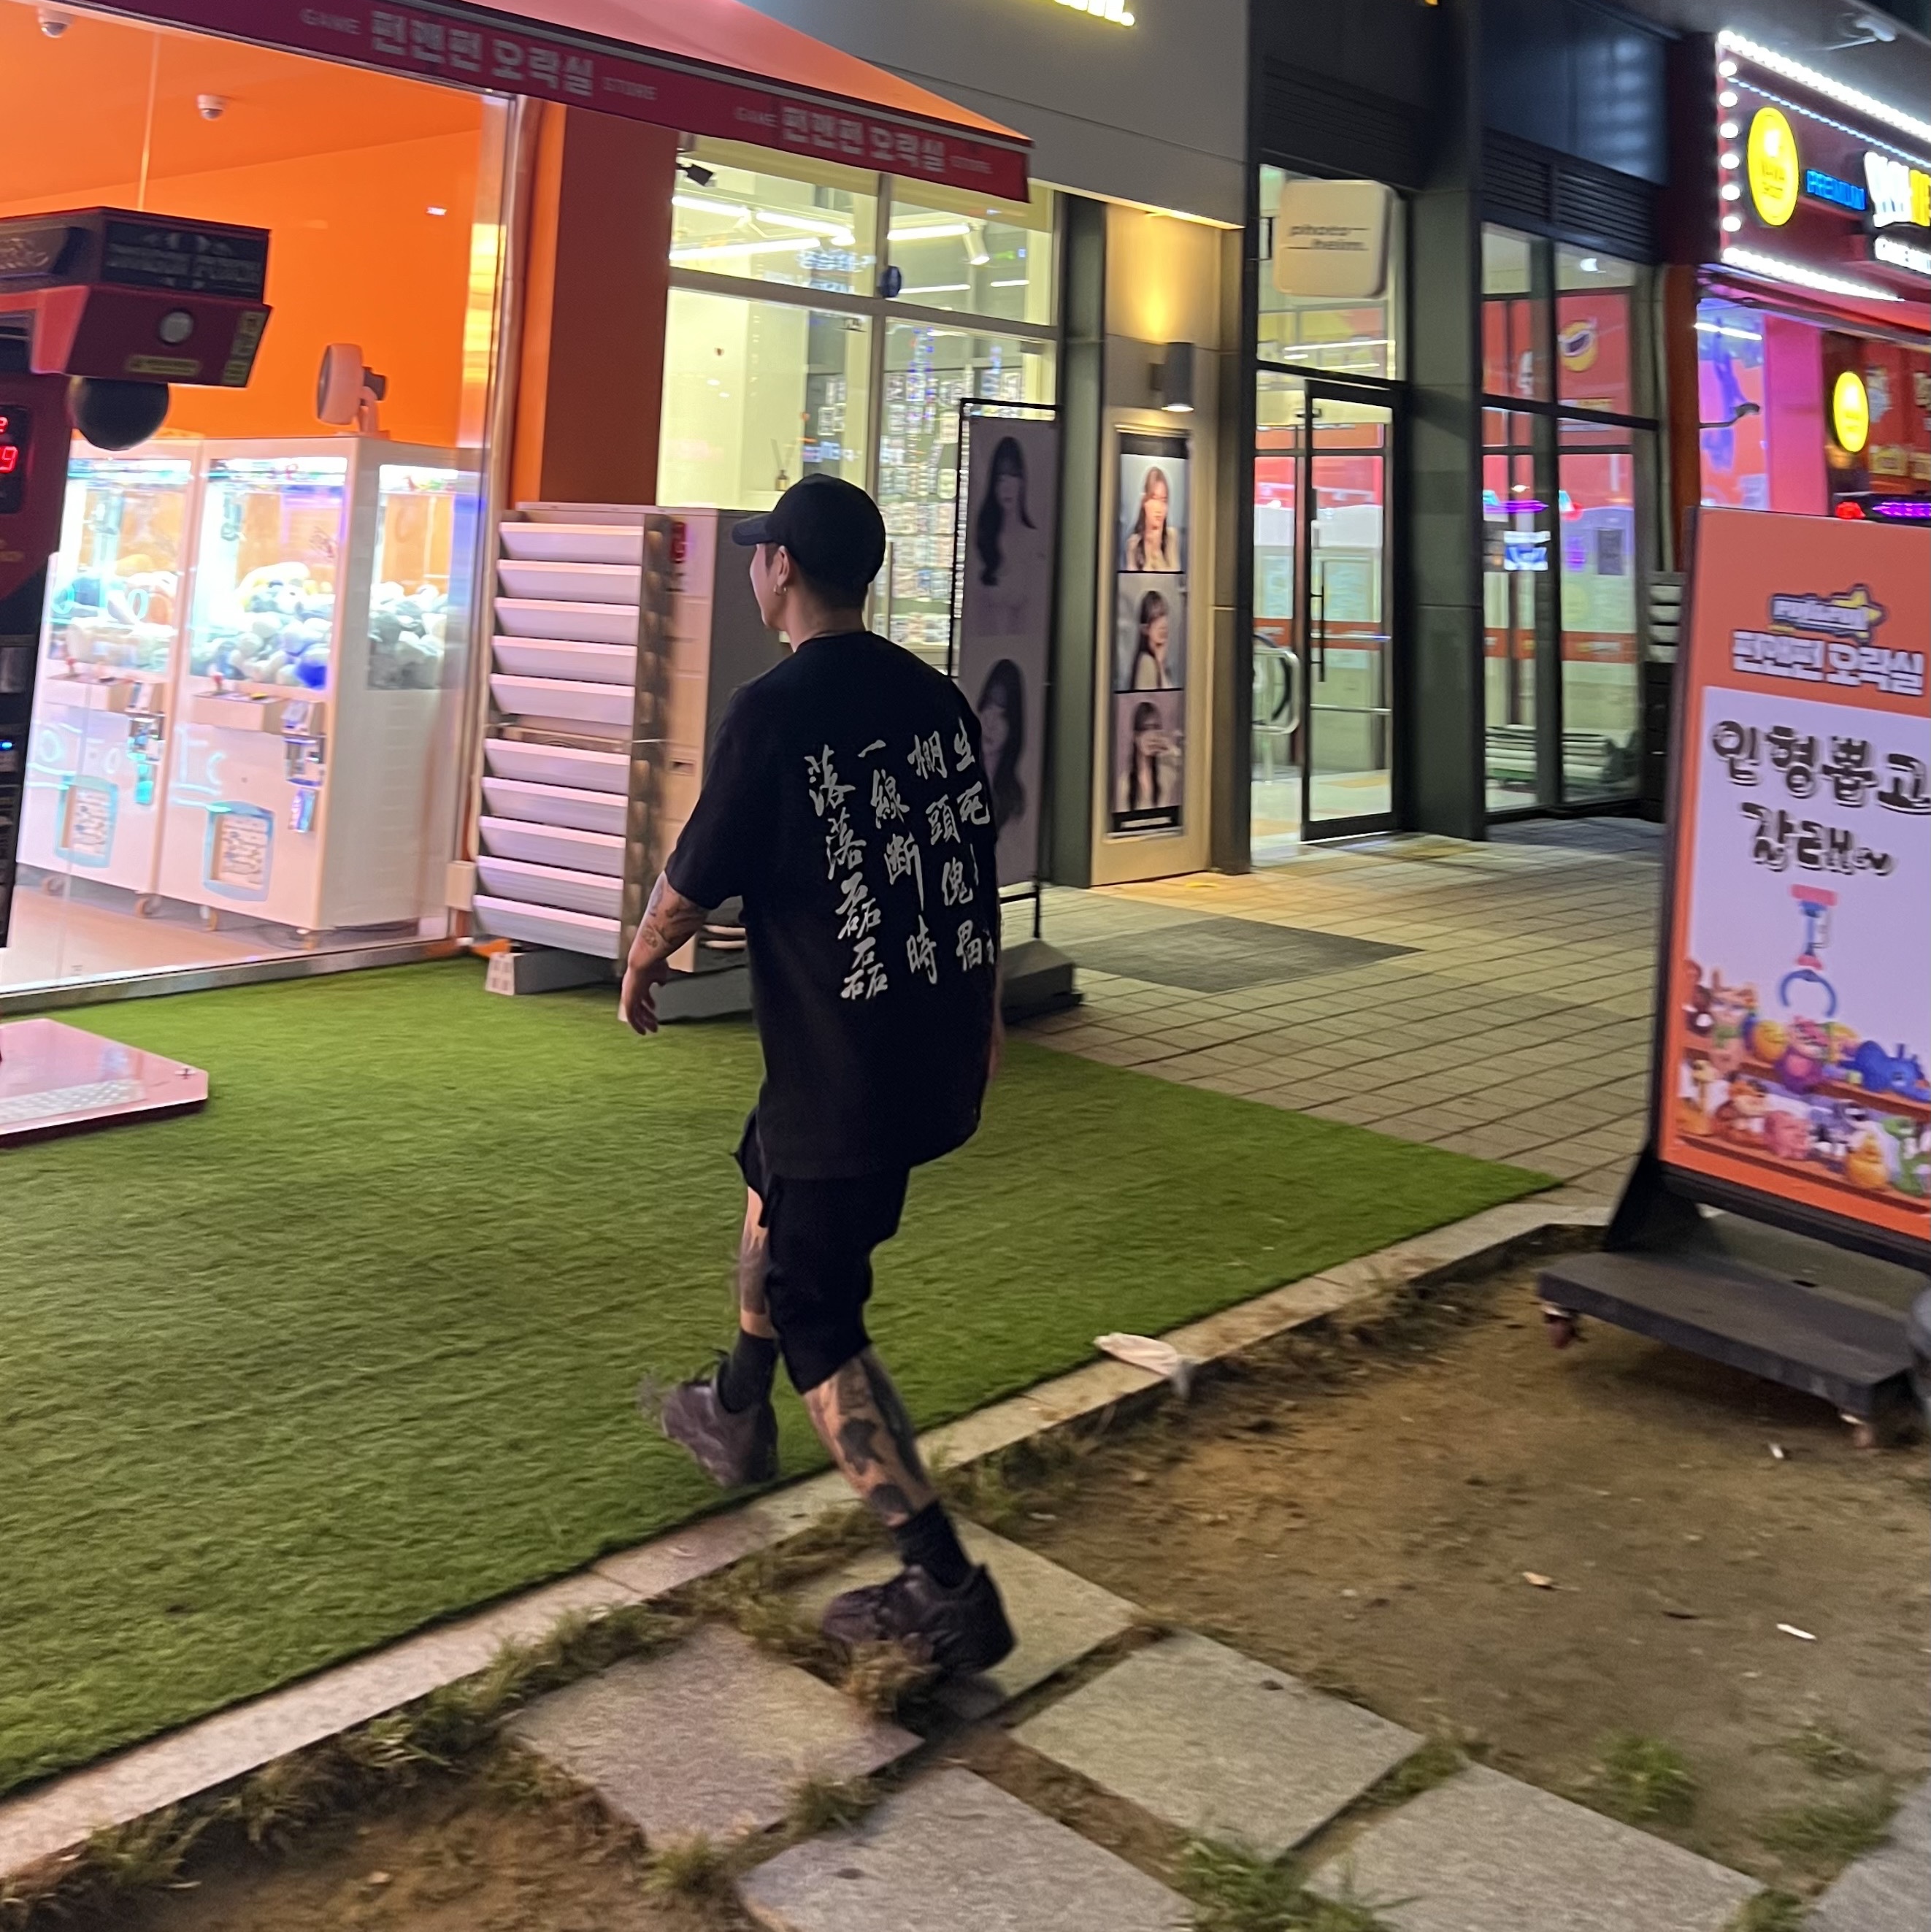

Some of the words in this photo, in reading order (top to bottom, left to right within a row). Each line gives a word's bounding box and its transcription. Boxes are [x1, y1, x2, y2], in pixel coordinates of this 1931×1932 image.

[491, 38, 594, 98] 오락실
[869, 126, 945, 173] 오락실
[1826, 641, 1924, 696] 오락실
[1712, 720, 1931, 816] 인형뽑고
